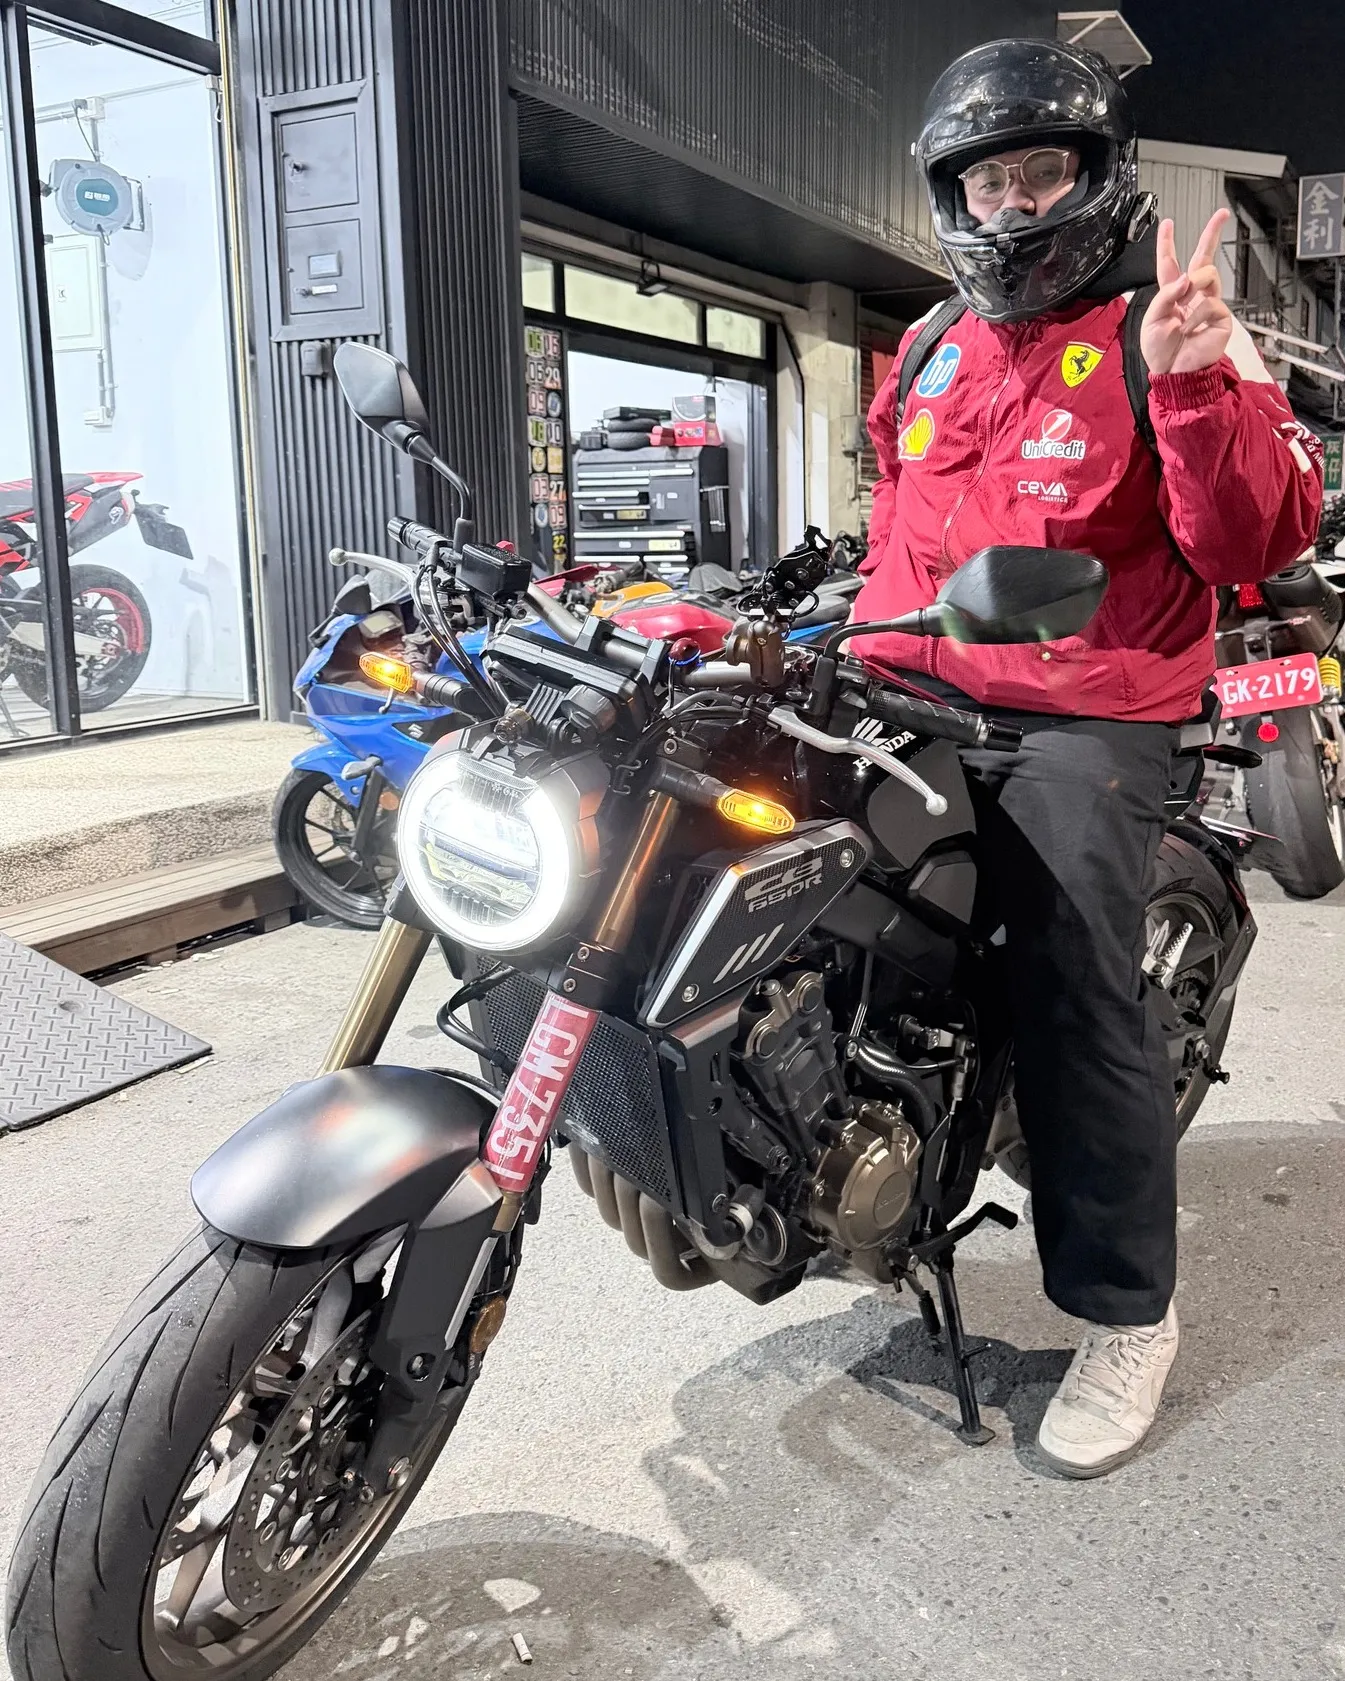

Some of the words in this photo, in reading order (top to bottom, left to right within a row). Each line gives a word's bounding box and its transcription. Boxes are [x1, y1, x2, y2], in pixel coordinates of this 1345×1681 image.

[1304, 181, 1340, 251] 金利
[920, 347, 960, 396] hp
[1022, 440, 1085, 459] UniCredit
[549, 480, 565, 500] 27
[1221, 667, 1316, 705] GK-2179
[852, 730, 917, 777] HNDA
[748, 873, 822, 913] 650R
[484, 999, 589, 1182] LGM-7351
